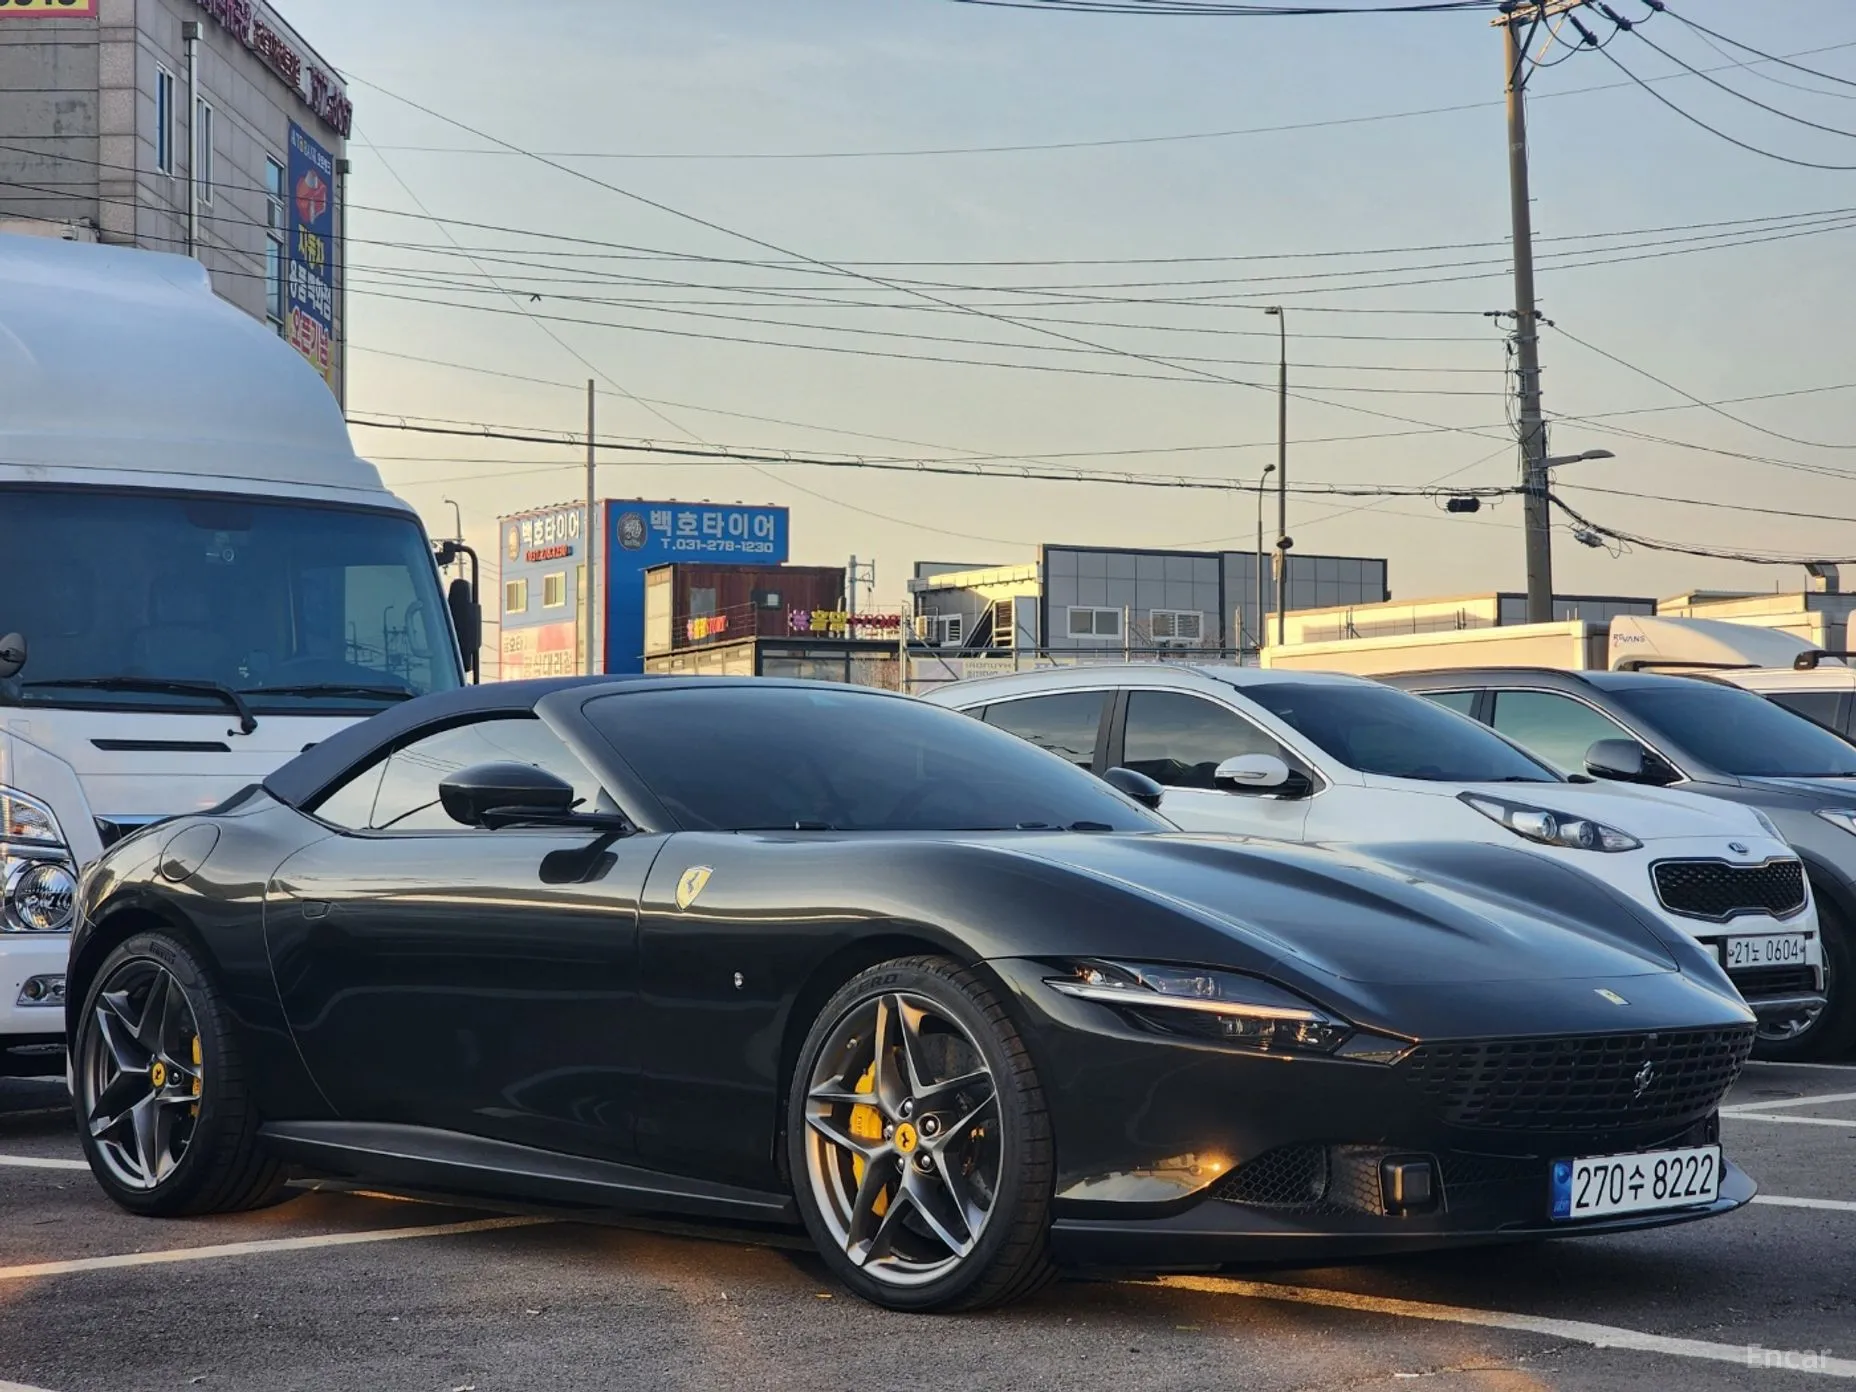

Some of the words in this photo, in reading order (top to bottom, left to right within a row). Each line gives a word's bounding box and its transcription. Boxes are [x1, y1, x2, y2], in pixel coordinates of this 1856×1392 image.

[298, 224, 325, 276] 자동차
[522, 510, 580, 548] 백호타이어
[651, 510, 775, 541] 백호타이어
[1735, 941, 1760, 964] 21노
[1766, 939, 1798, 961] 0604
[1575, 1162, 1645, 1209] 270수
[1652, 1153, 1713, 1200] 8222
